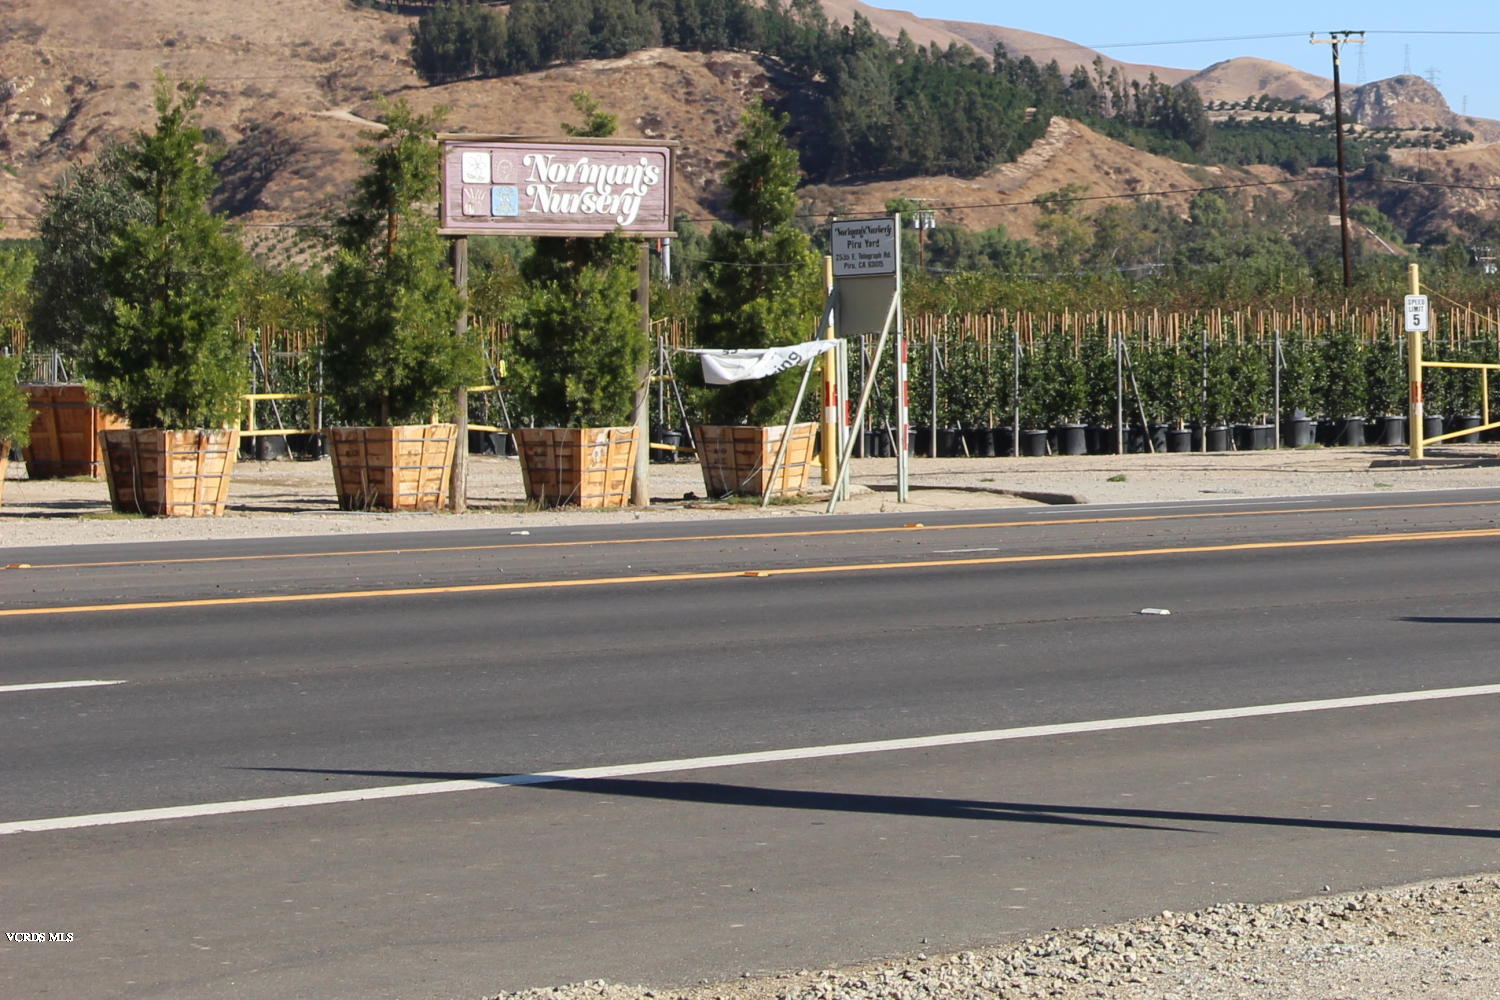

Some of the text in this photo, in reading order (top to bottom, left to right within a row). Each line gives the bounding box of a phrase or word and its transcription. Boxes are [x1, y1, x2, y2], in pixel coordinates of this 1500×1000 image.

[523, 153, 660, 196] Norman's
[526, 183, 645, 226] Nursery
[847, 239, 880, 249] Piru Yard
[1413, 313, 1420, 326] 5
